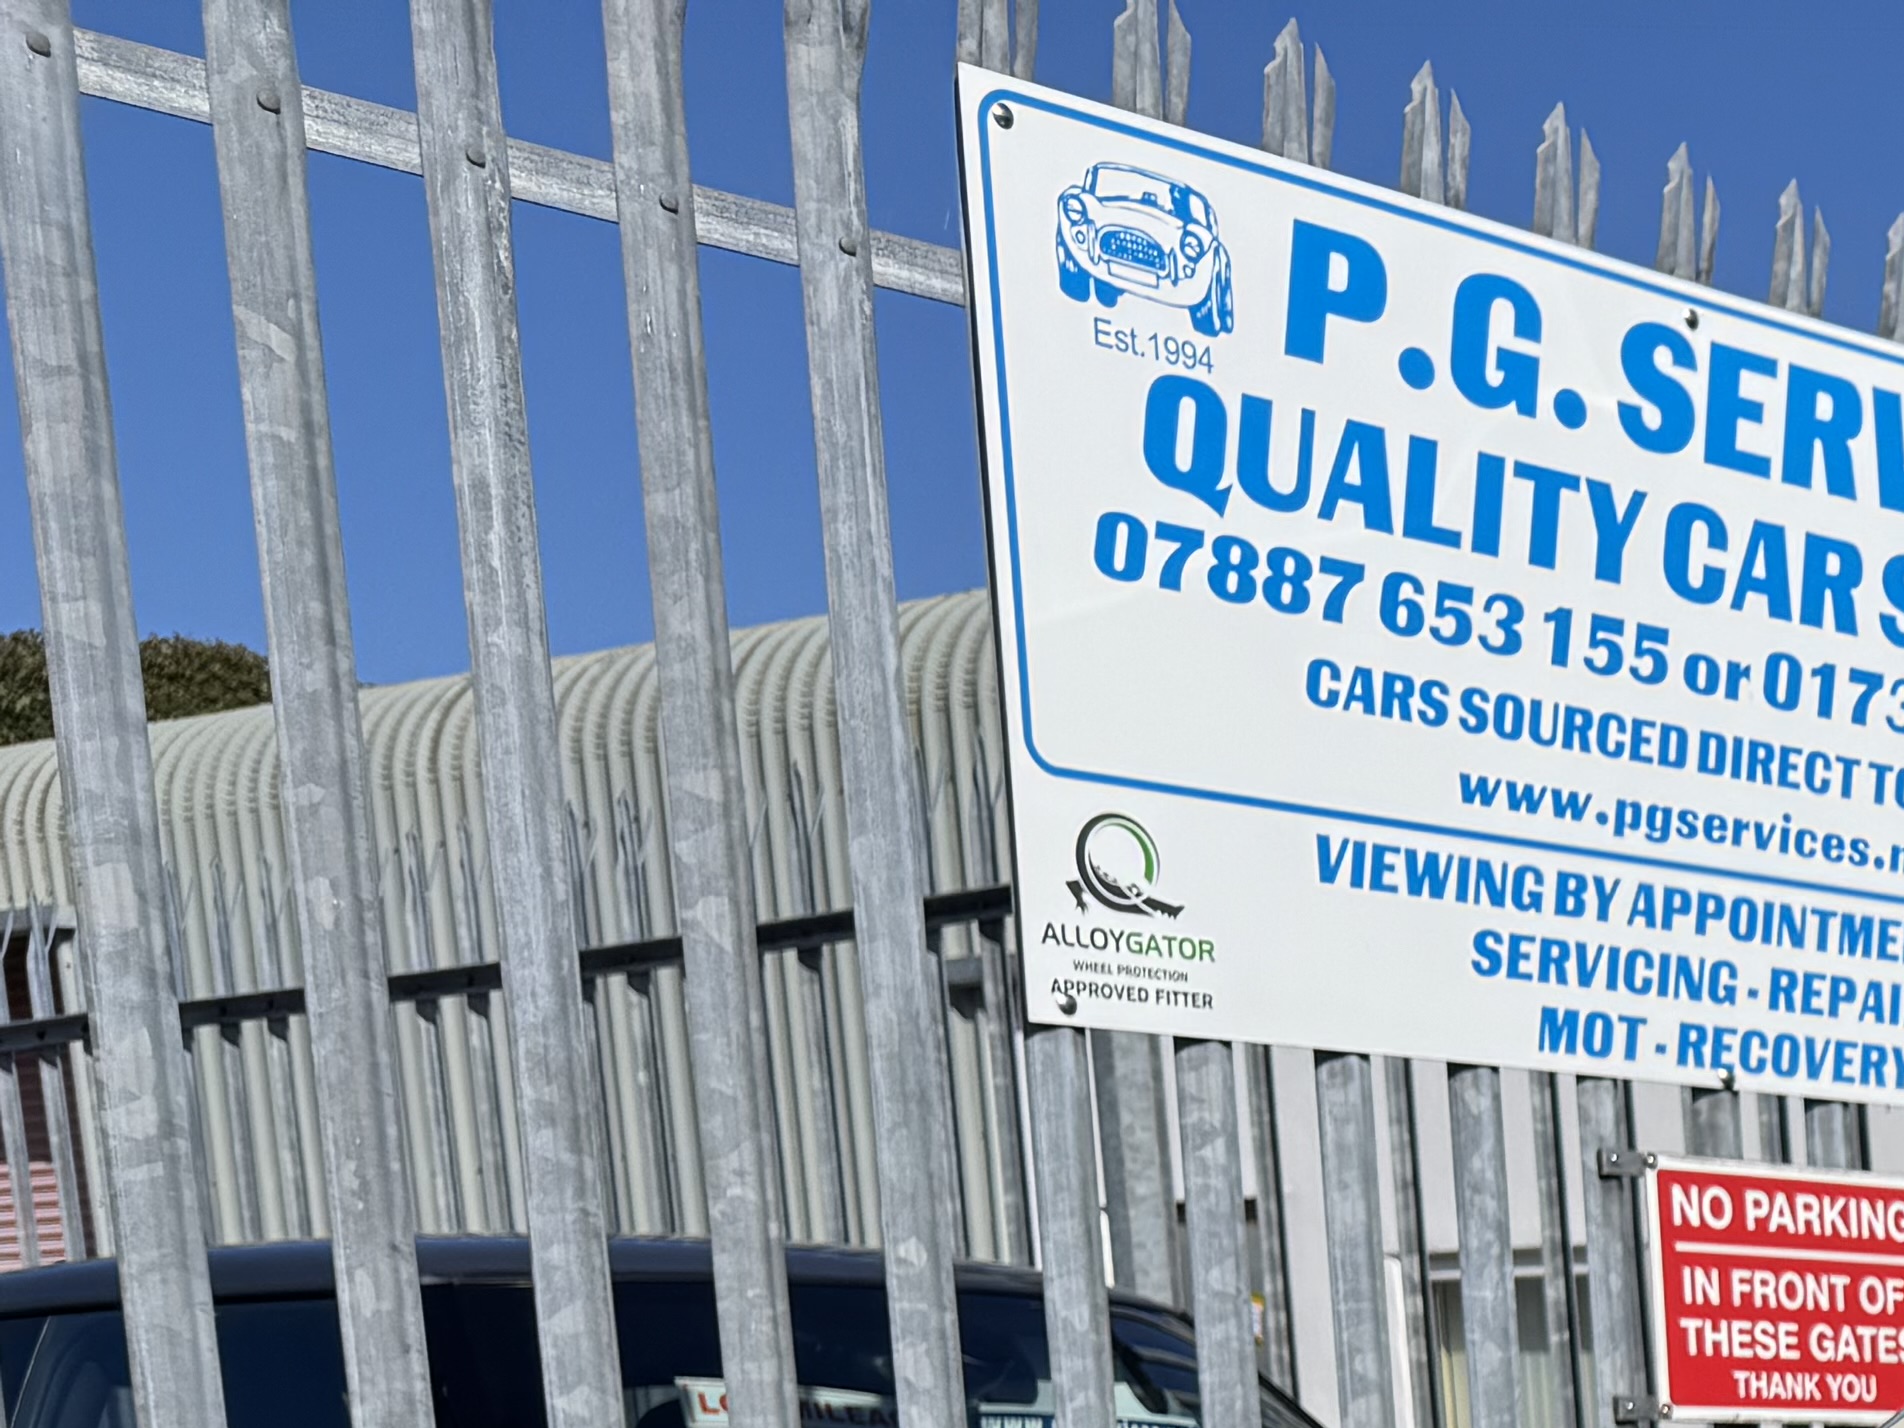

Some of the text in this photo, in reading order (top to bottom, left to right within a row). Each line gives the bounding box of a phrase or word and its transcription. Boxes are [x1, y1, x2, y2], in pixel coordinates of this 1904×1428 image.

[1093, 316, 1215, 375] Est.1994
[1284, 219, 1588, 430] P.G.
[1142, 374, 1648, 585] QUALITY
[1663, 502, 1864, 637] CAR
[1093, 511, 1366, 624] 07887
[1379, 571, 1525, 657] 653
[1543, 607, 1670, 686] 155
[1683, 653, 1752, 703] or
[1306, 658, 1450, 728] CARS
[1459, 687, 1689, 770] SOURCED
[1697, 730, 1862, 800] DIRECT
[1316, 834, 1545, 914] VIEWING
[1554, 870, 1621, 923] BY
[1041, 921, 1216, 963] ALLOYGATOR
[1471, 929, 1738, 1006] SERVICING
[1051, 978, 1214, 1010] APPROVED FITTER
[1072, 958, 1189, 983] WHEEL PROTECTION
[1538, 1006, 1648, 1062] MOT
[1670, 1182, 1734, 1231] NO
[1681, 1265, 1721, 1307] IN
[1729, 1268, 1852, 1313] FRONT
[1678, 1316, 1801, 1361] THESE
[1733, 1369, 1878, 1403] THANK YOU
